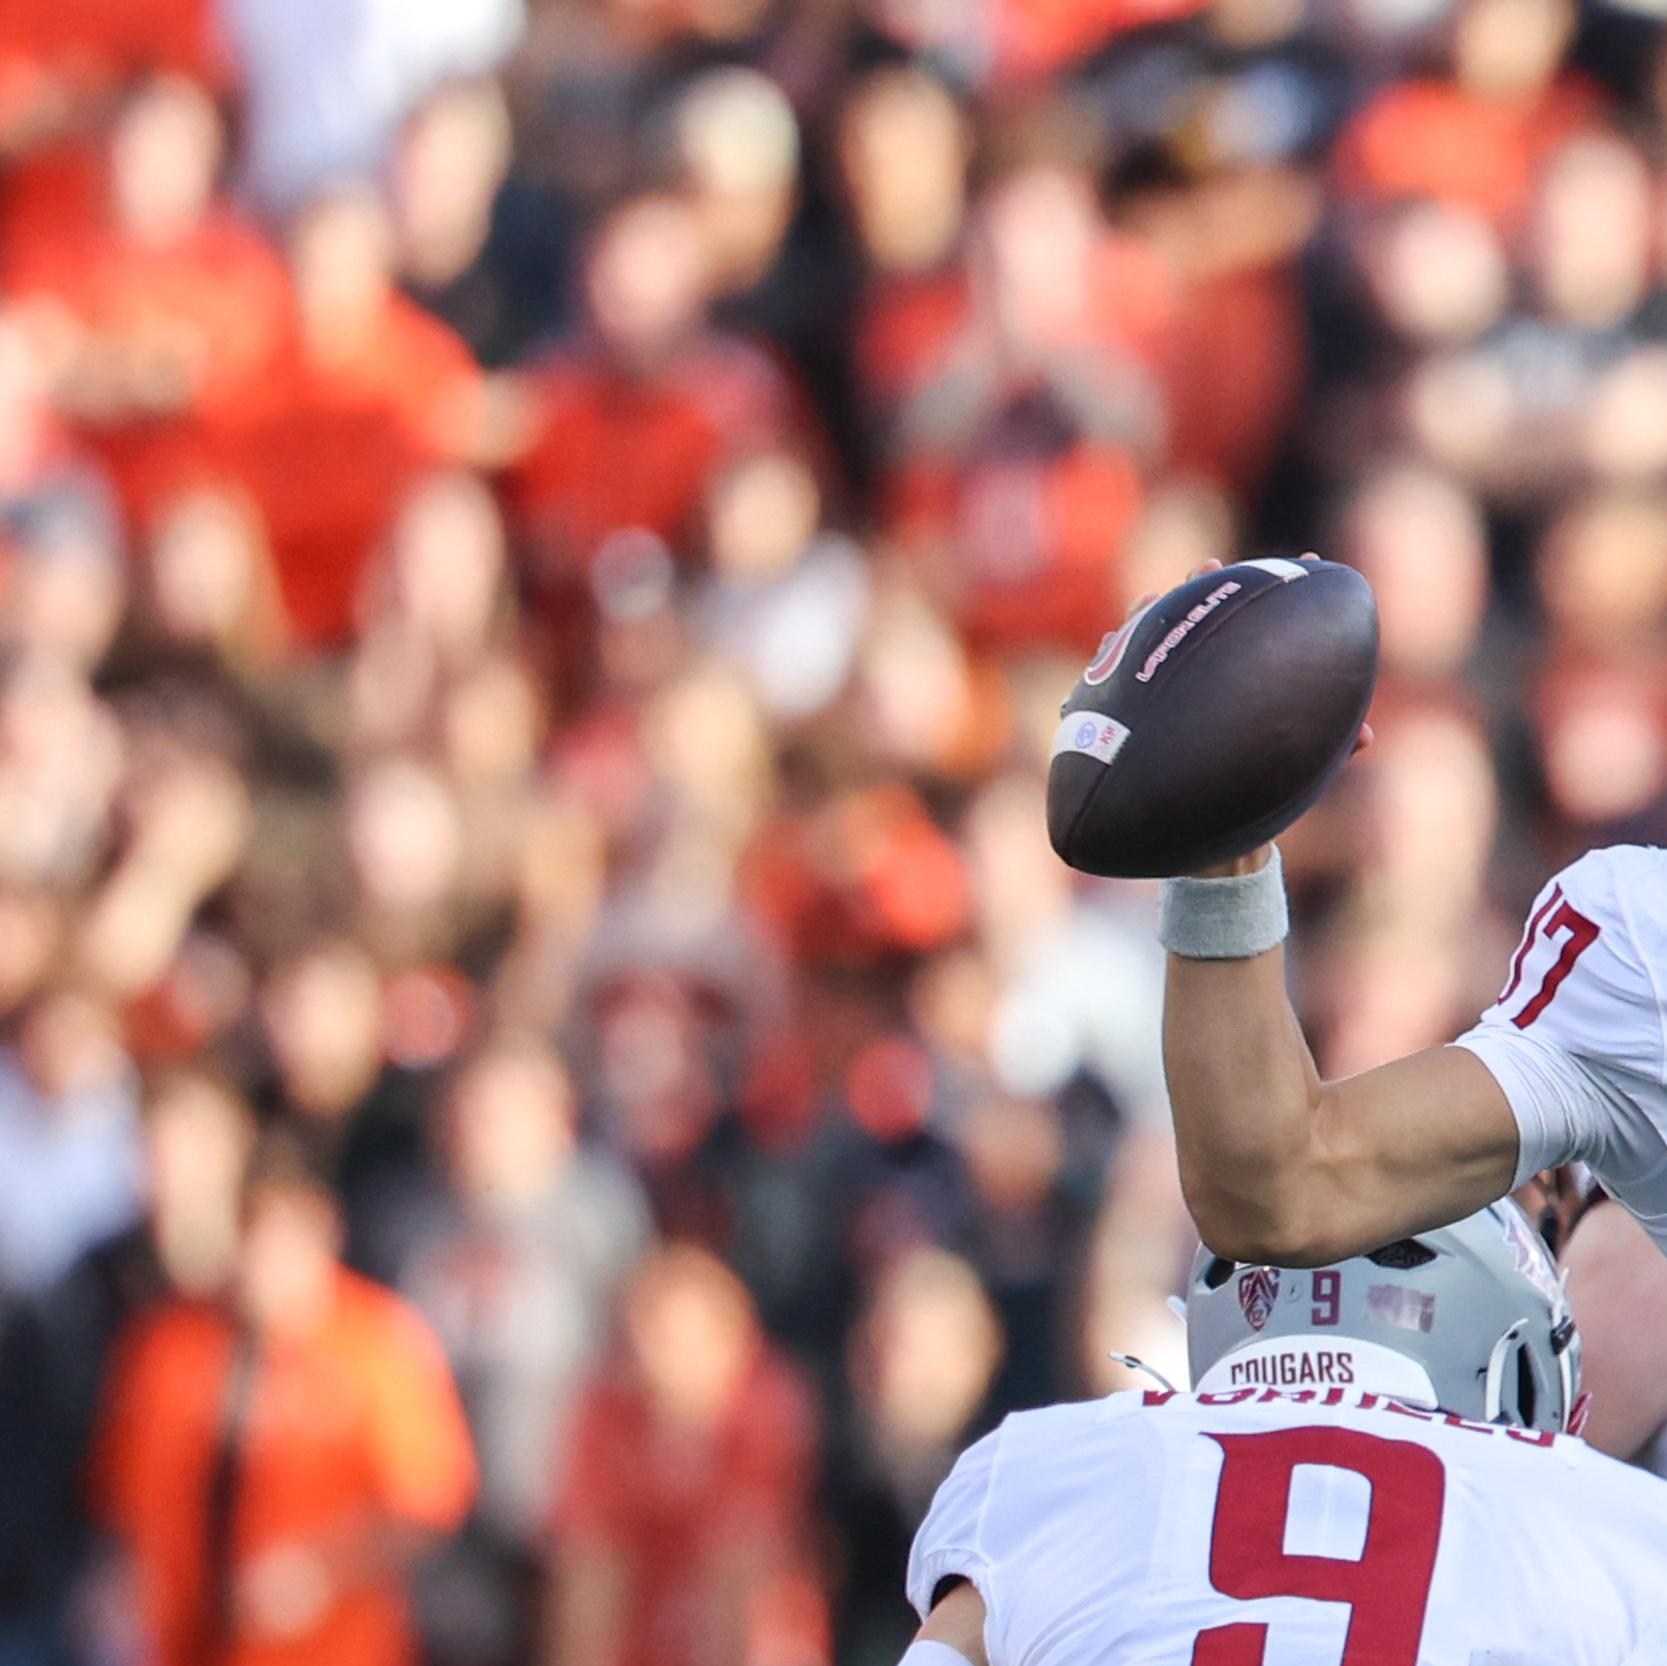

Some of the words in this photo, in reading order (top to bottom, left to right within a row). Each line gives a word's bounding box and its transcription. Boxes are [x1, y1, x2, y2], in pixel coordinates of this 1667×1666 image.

[1497, 881, 1602, 1031] 17
[1311, 1269, 1342, 1327] 9
[1230, 1351, 1355, 1386] COUGARS
